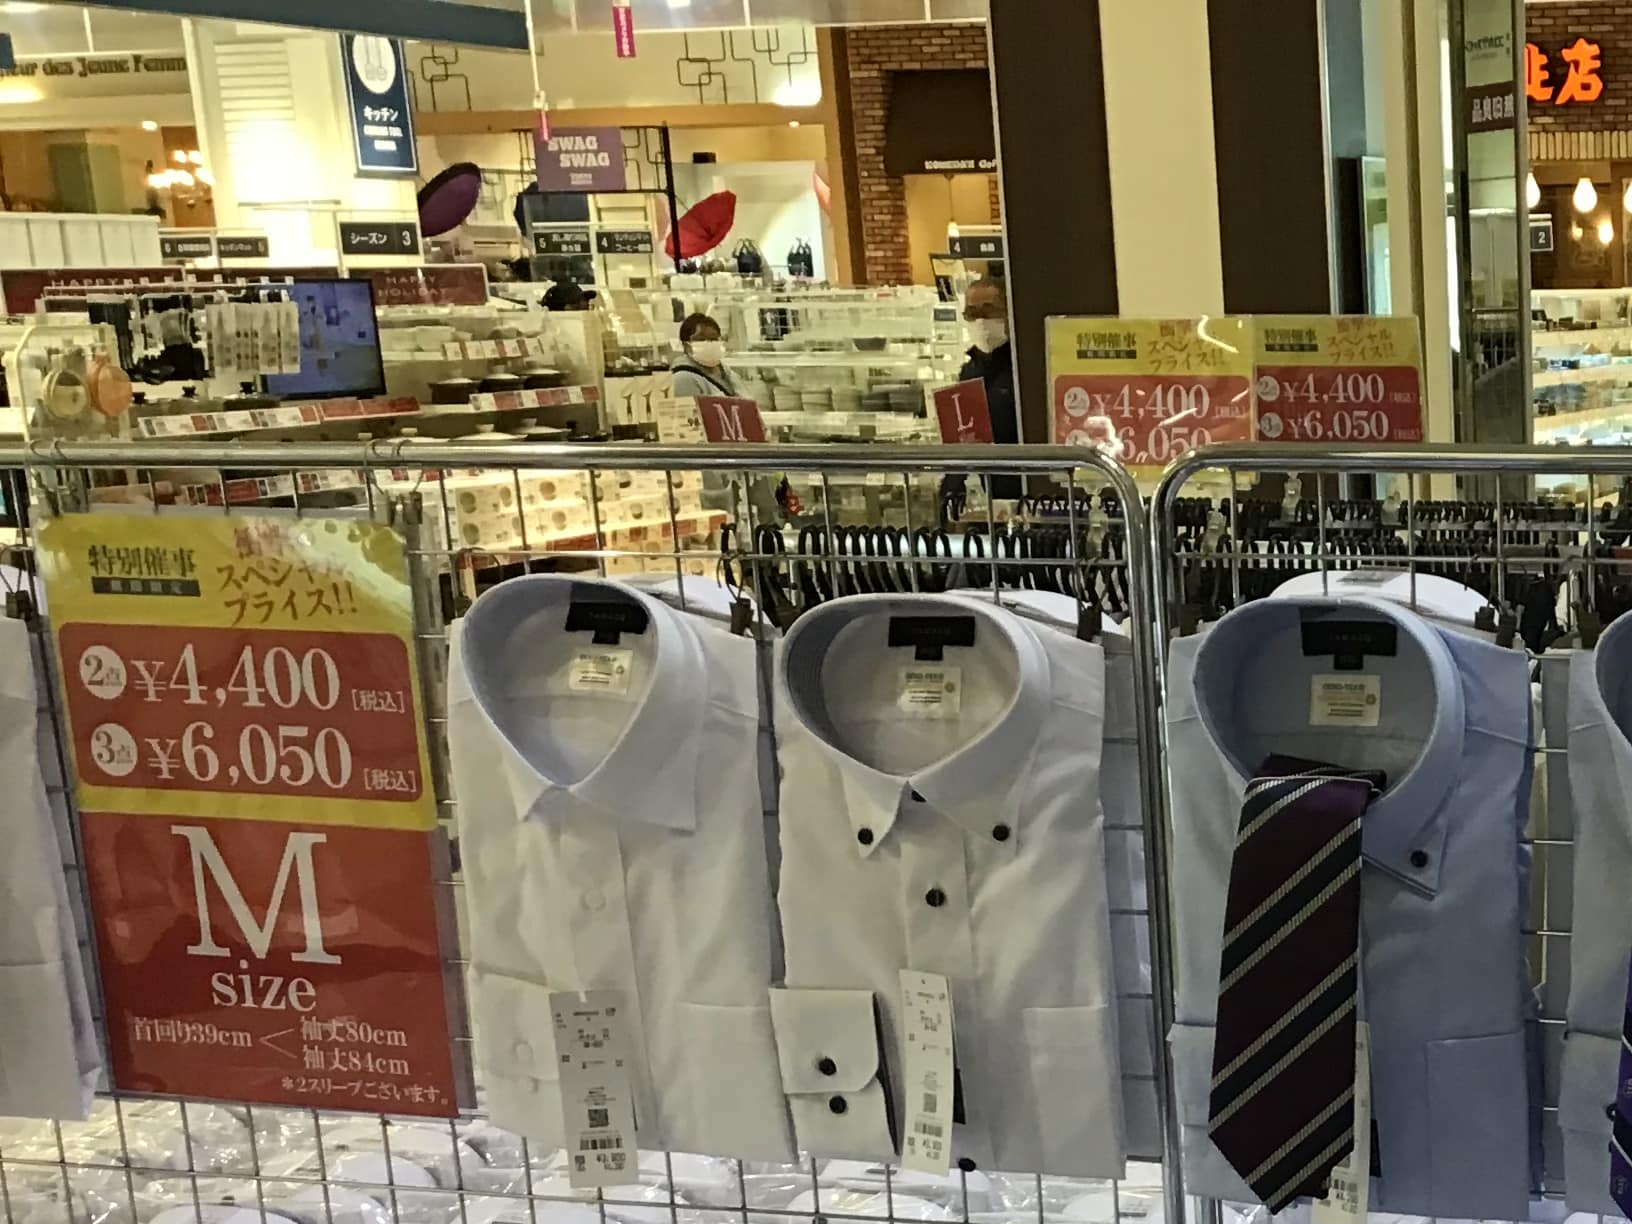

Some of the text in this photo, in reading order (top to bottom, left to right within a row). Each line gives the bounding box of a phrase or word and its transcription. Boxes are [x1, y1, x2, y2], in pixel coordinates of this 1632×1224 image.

[363, 105, 399, 122] キッチン
[548, 136, 598, 151] SWAG
[559, 152, 610, 168] SWAG
[350, 231, 411, 246] シーズン 3
[1538, 231, 1546, 244] 2
[713, 404, 749, 442] M
[952, 393, 975, 432] L
[88, 545, 197, 578] 特別催事
[223, 578, 360, 627] プライス!!
[131, 642, 341, 713] ¥4,400
[351, 688, 405, 714] [税込]
[145, 720, 353, 790] ¥6,050
[363, 767, 418, 793] [税込]
[170, 824, 343, 965] M
[210, 958, 317, 1012] size
[300, 1015, 408, 1048] 袖丈80cm
[302, 1043, 411, 1076] 袖丈84cm
